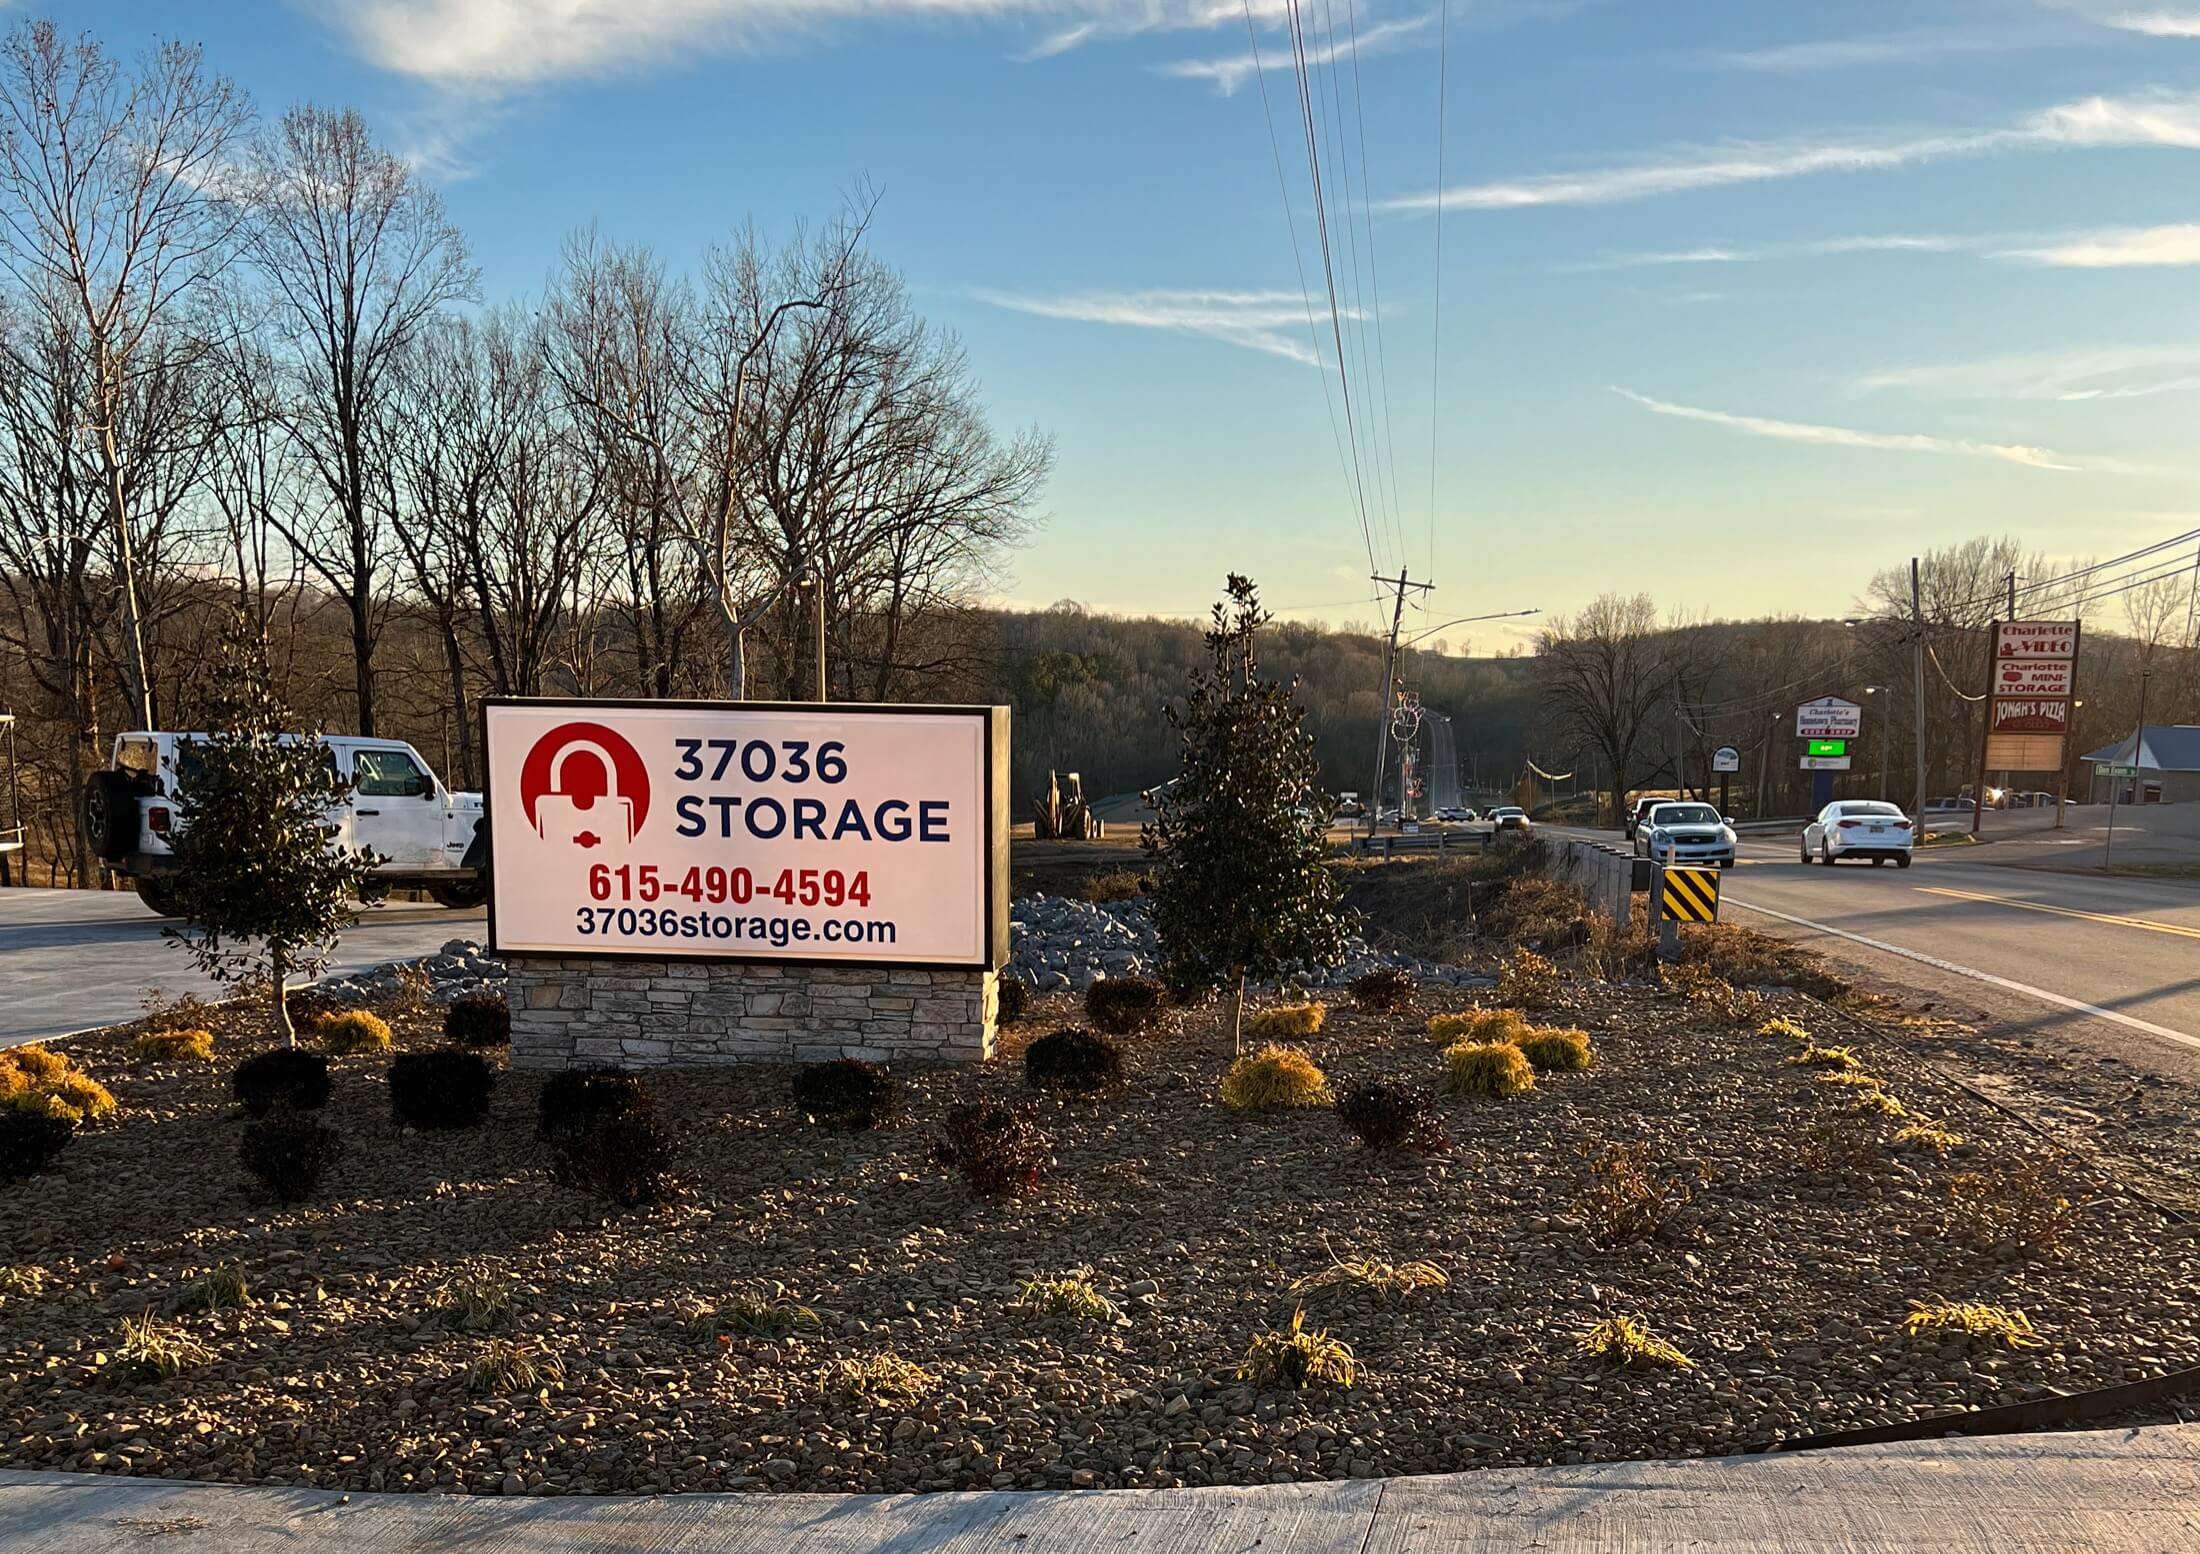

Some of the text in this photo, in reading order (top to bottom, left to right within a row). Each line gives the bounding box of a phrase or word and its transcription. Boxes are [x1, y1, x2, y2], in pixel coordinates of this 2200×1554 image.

[2002, 626, 2073, 636] Charlotte
[2021, 640, 2072, 653] VIDEO
[2001, 663, 2068, 671] Charlotte
[2031, 673, 2067, 682] MINI-
[1999, 684, 2067, 692] STORAGE
[1995, 701, 2066, 727] JONAH'S PIZZA
[674, 738, 848, 784] 37036
[675, 796, 951, 843] STORAGE
[446, 841, 464, 849] Jeep
[588, 863, 872, 908] 615-490-4594
[576, 907, 897, 946] 37036storage.com
